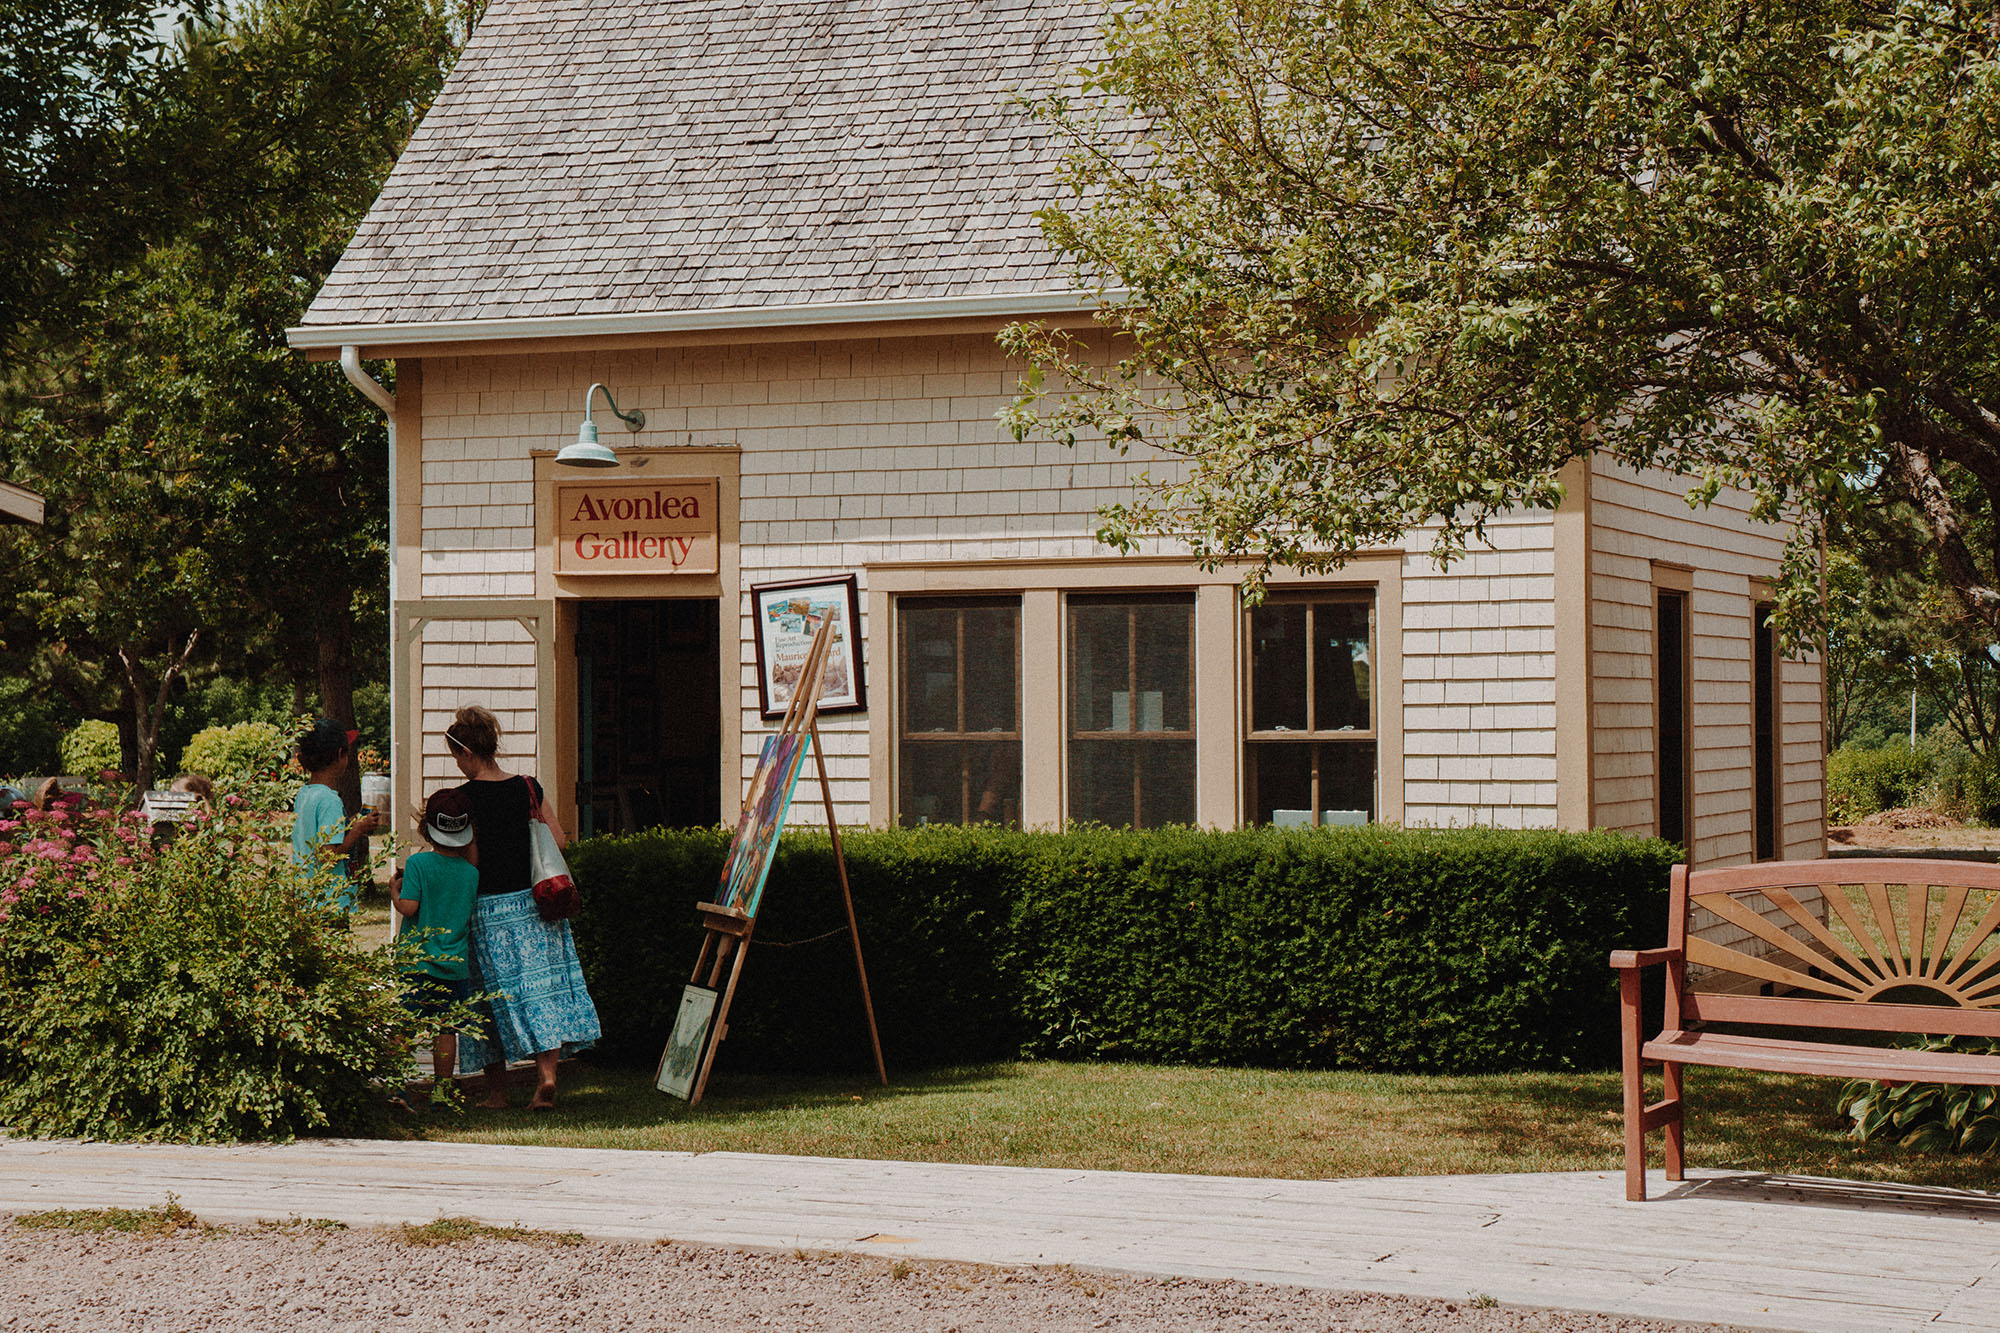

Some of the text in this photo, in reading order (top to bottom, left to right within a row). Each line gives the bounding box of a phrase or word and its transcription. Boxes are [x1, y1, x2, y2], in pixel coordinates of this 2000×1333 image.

[570, 491, 700, 521] Avonlea
[575, 530, 696, 566] Gallery
[775, 640, 812, 649] Reproduction
[776, 652, 808, 661] Maurice
